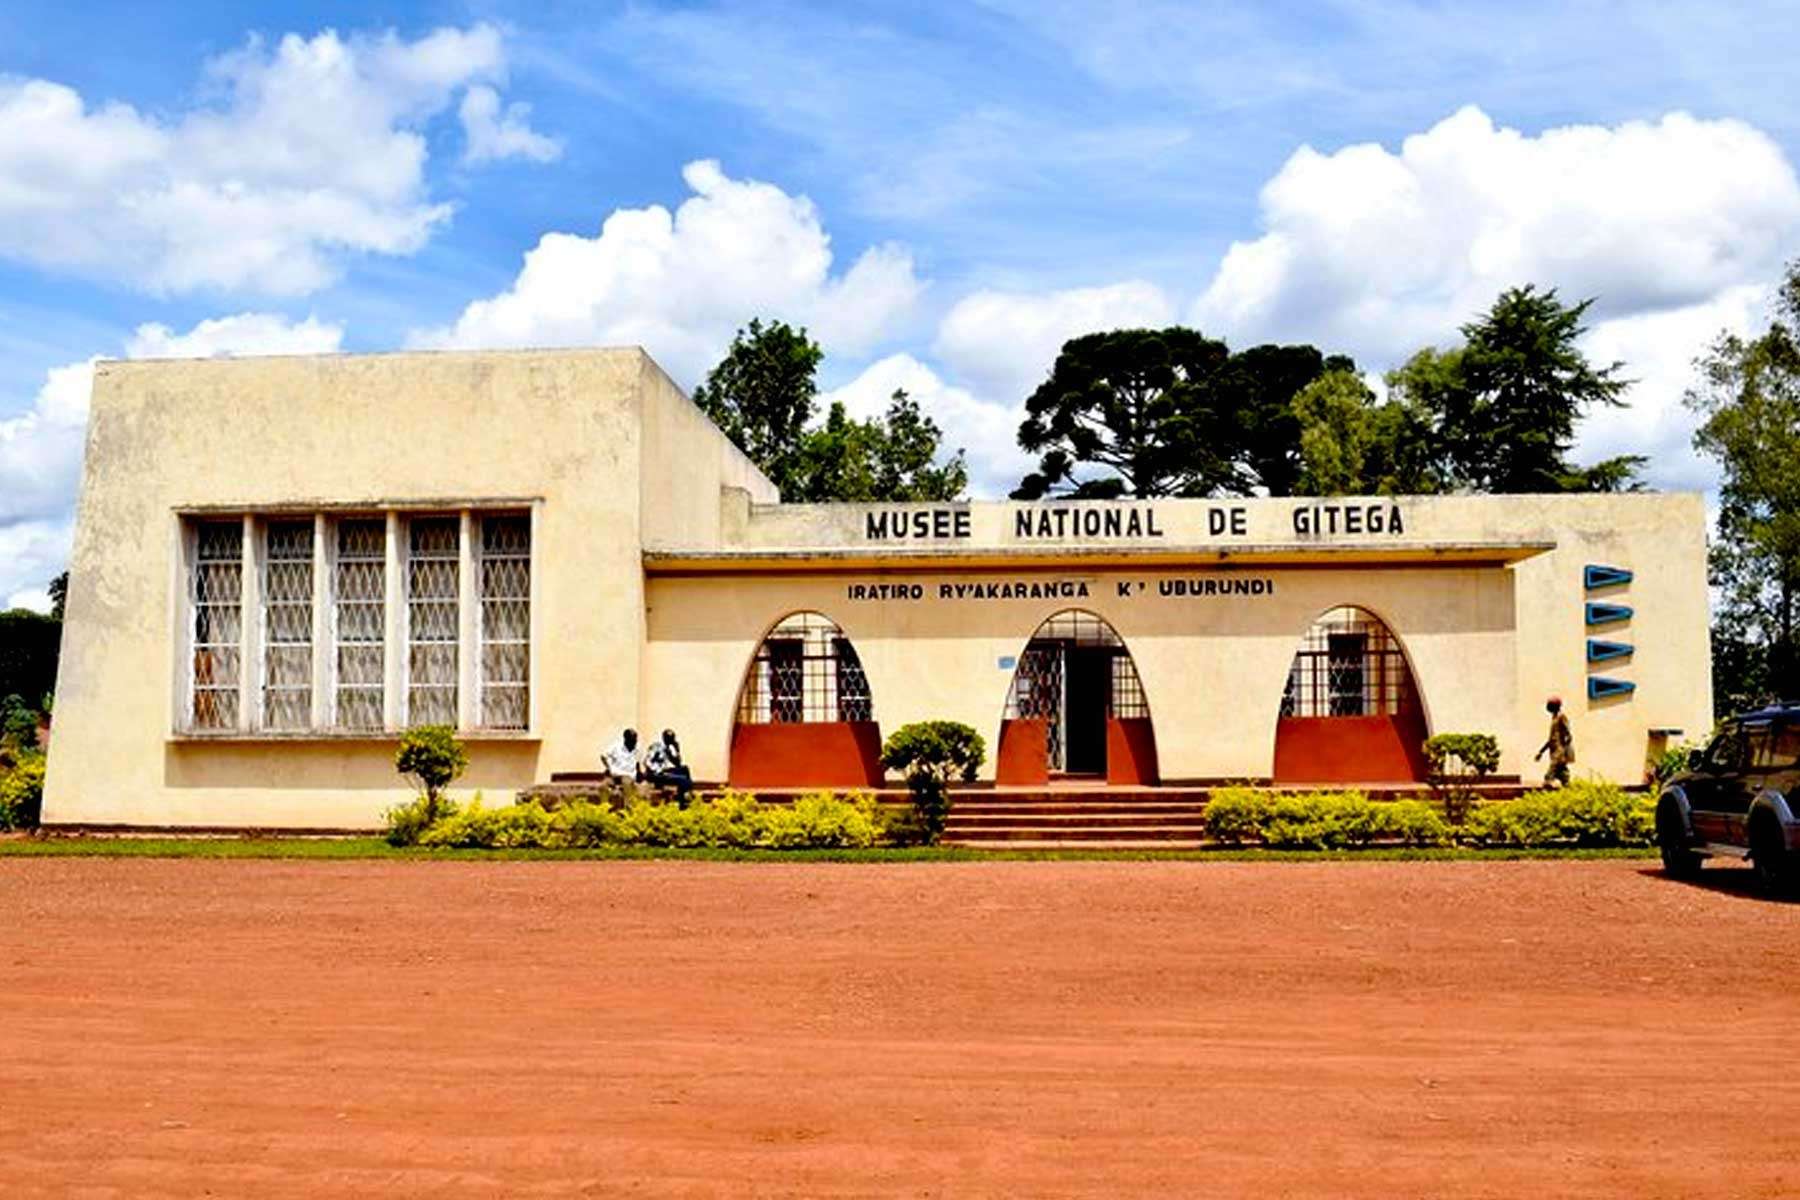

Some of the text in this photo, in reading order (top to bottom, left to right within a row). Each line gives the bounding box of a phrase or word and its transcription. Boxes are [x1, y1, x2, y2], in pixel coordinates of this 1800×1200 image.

[867, 505, 1404, 539] MUSEE NATIONAL DE GITEGA
[848, 583, 924, 600] IRATIRO
[940, 581, 1090, 599] RY'AKARANGA
[1159, 578, 1274, 597] UBURUNDI
